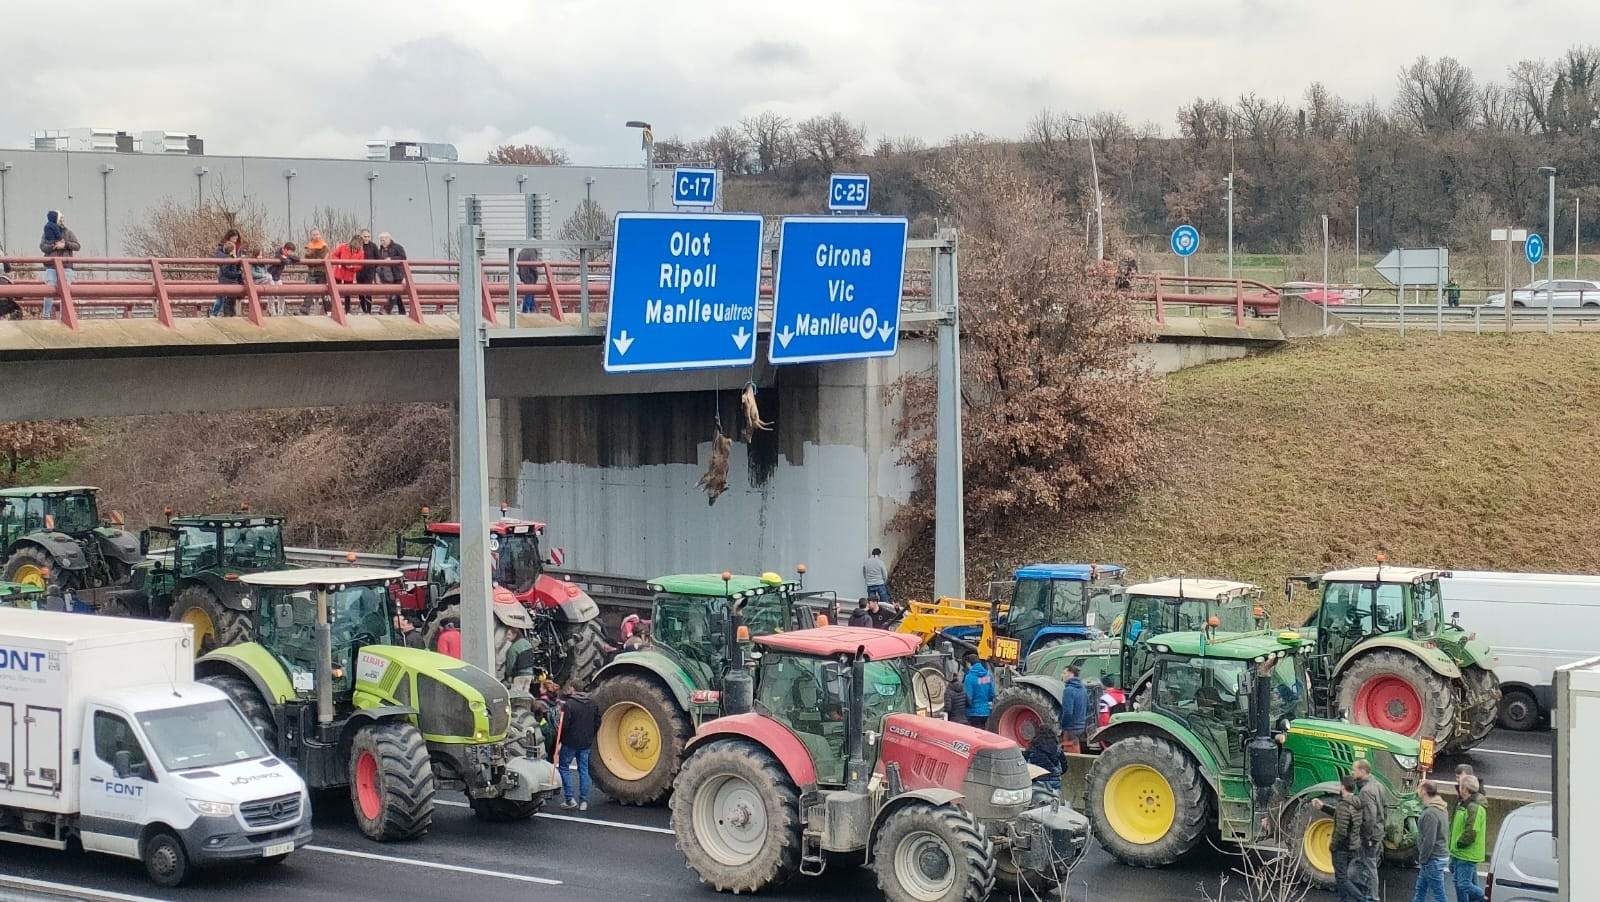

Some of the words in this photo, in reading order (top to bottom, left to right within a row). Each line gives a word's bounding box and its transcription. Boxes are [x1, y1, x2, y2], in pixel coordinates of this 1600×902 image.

[679, 177, 711, 197] C-17
[834, 183, 865, 202] C-25
[670, 231, 711, 256] Olot
[816, 243, 871, 267] Girona
[659, 263, 717, 294] Ripoll
[828, 279, 855, 302] Vic
[645, 298, 724, 324] Manlleu
[723, 303, 753, 321] altres
[796, 312, 859, 336] Manlleu
[105, 782, 144, 797] FONT
